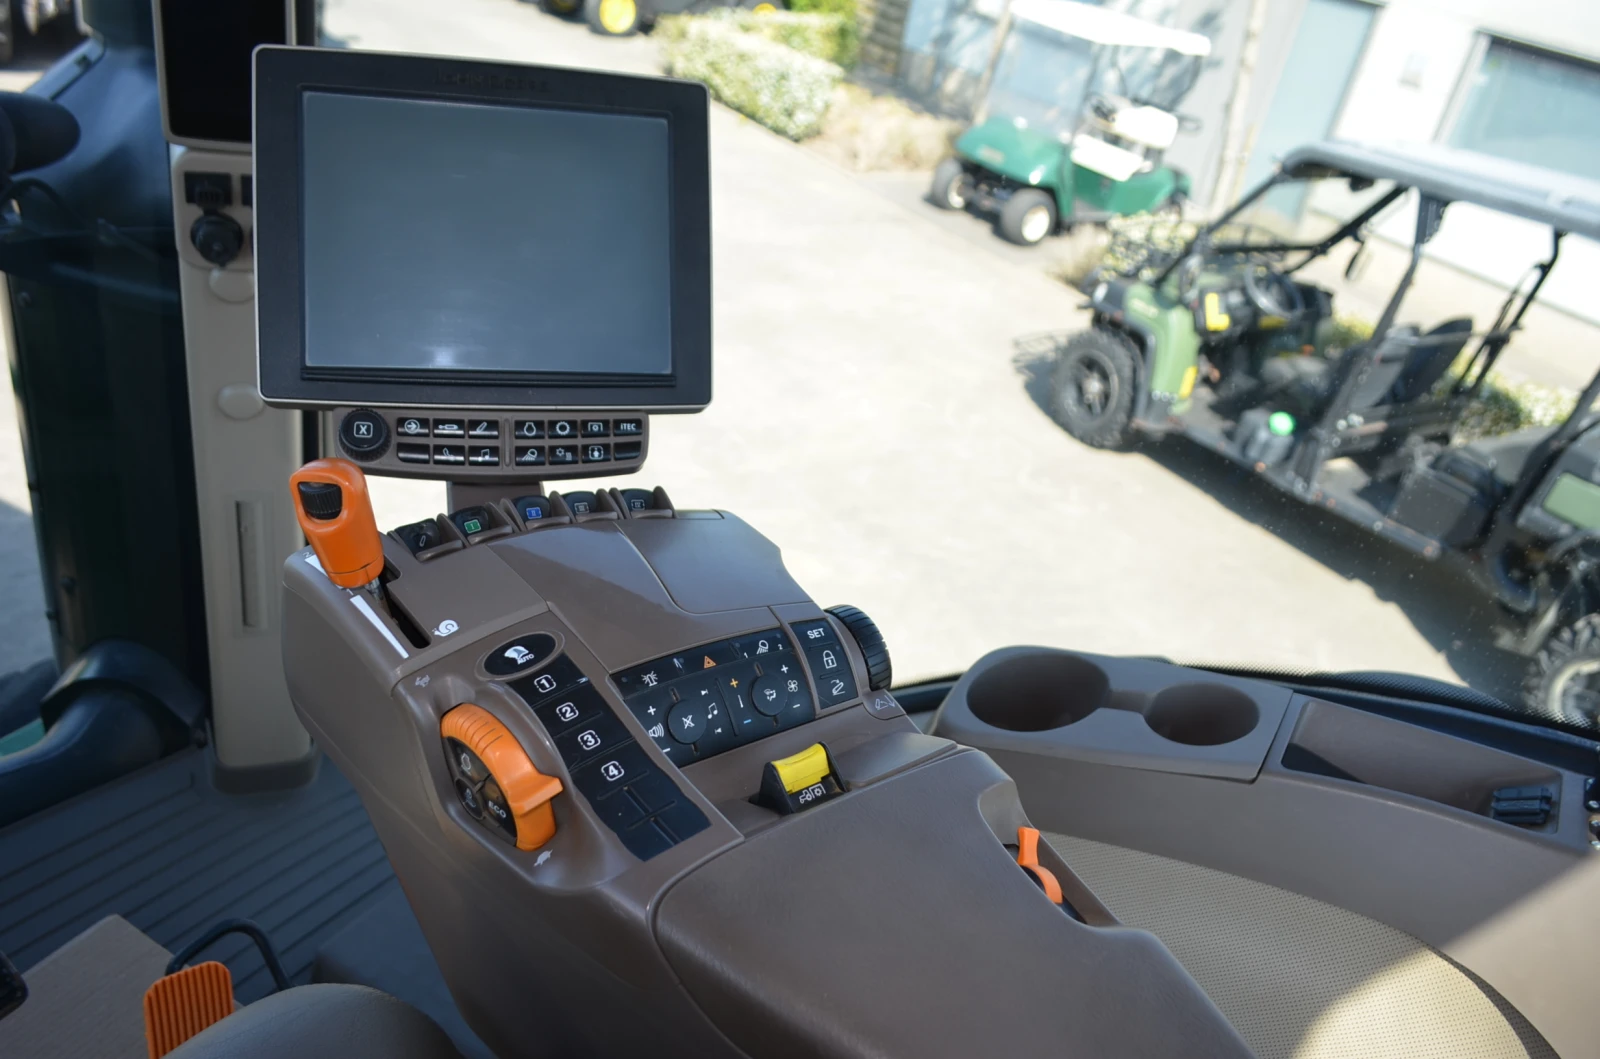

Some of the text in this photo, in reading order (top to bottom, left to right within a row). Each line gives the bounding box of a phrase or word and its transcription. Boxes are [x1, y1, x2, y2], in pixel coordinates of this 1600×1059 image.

[359, 424, 368, 435] X
[806, 628, 826, 639] SET
[517, 653, 535, 665] AUTO
[539, 678, 550, 689] 1
[561, 706, 574, 718] 2
[583, 734, 596, 746] 3
[608, 765, 619, 776] 4
[488, 800, 507, 818] ECO
